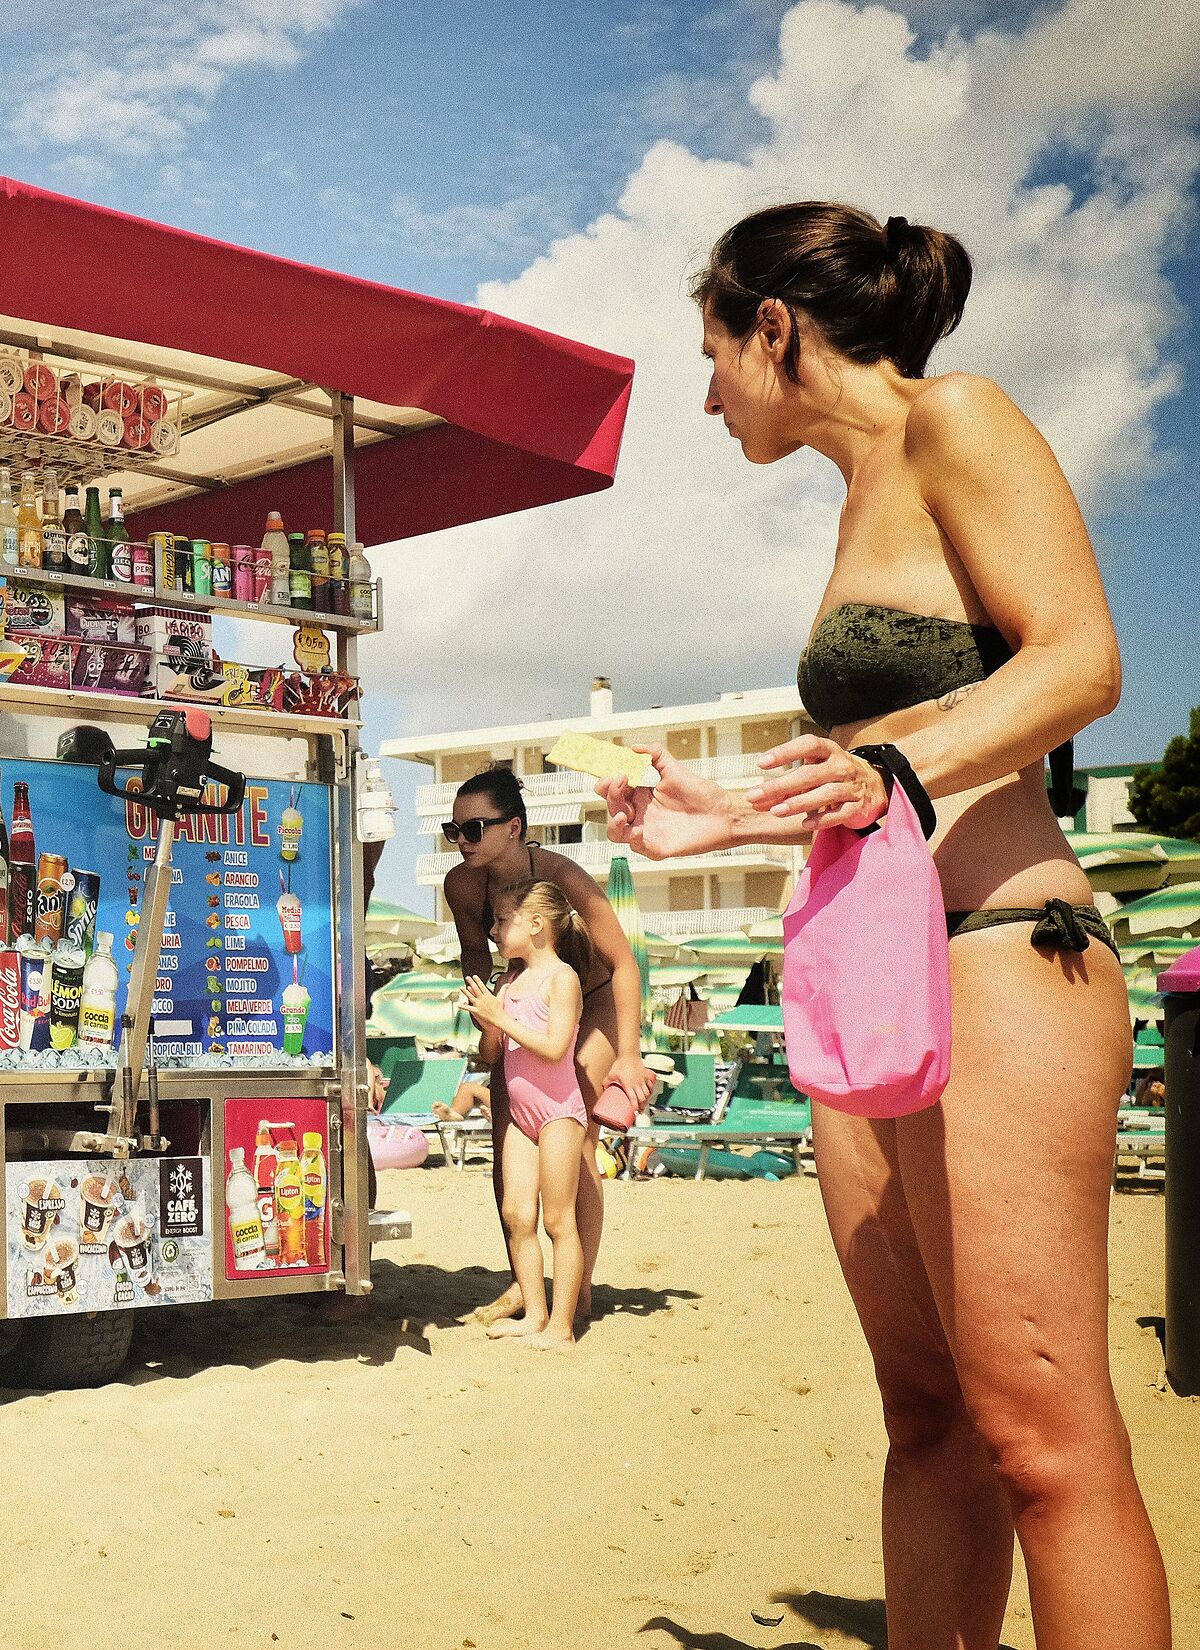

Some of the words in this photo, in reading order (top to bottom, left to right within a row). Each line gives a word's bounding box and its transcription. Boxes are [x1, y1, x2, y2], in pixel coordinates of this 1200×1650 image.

[126, 776, 270, 847] GANITE
[224, 852, 248, 865] ANICE
[224, 873, 259, 886] ARANCIO
[224, 894, 259, 907] FRAGOLA
[225, 915, 250, 928] PESCA
[225, 936, 245, 949] LIME
[226, 958, 268, 971] POMPELMO
[226, 979, 256, 992] MOJITO
[52, 995, 80, 1010] SODA
[227, 1000, 248, 1013] MELA
[249, 1001, 272, 1013] VERDE
[227, 1018, 246, 1034] PIÑA
[247, 1021, 277, 1034] COLADA
[229, 1043, 273, 1055] TAMARINDO
[280, 1187, 299, 1198] Lipton
[39, 1199, 65, 1210] ESPRESSO
[166, 1194, 196, 1212] CAFÉ
[182, 1226, 198, 1234] BOOST
